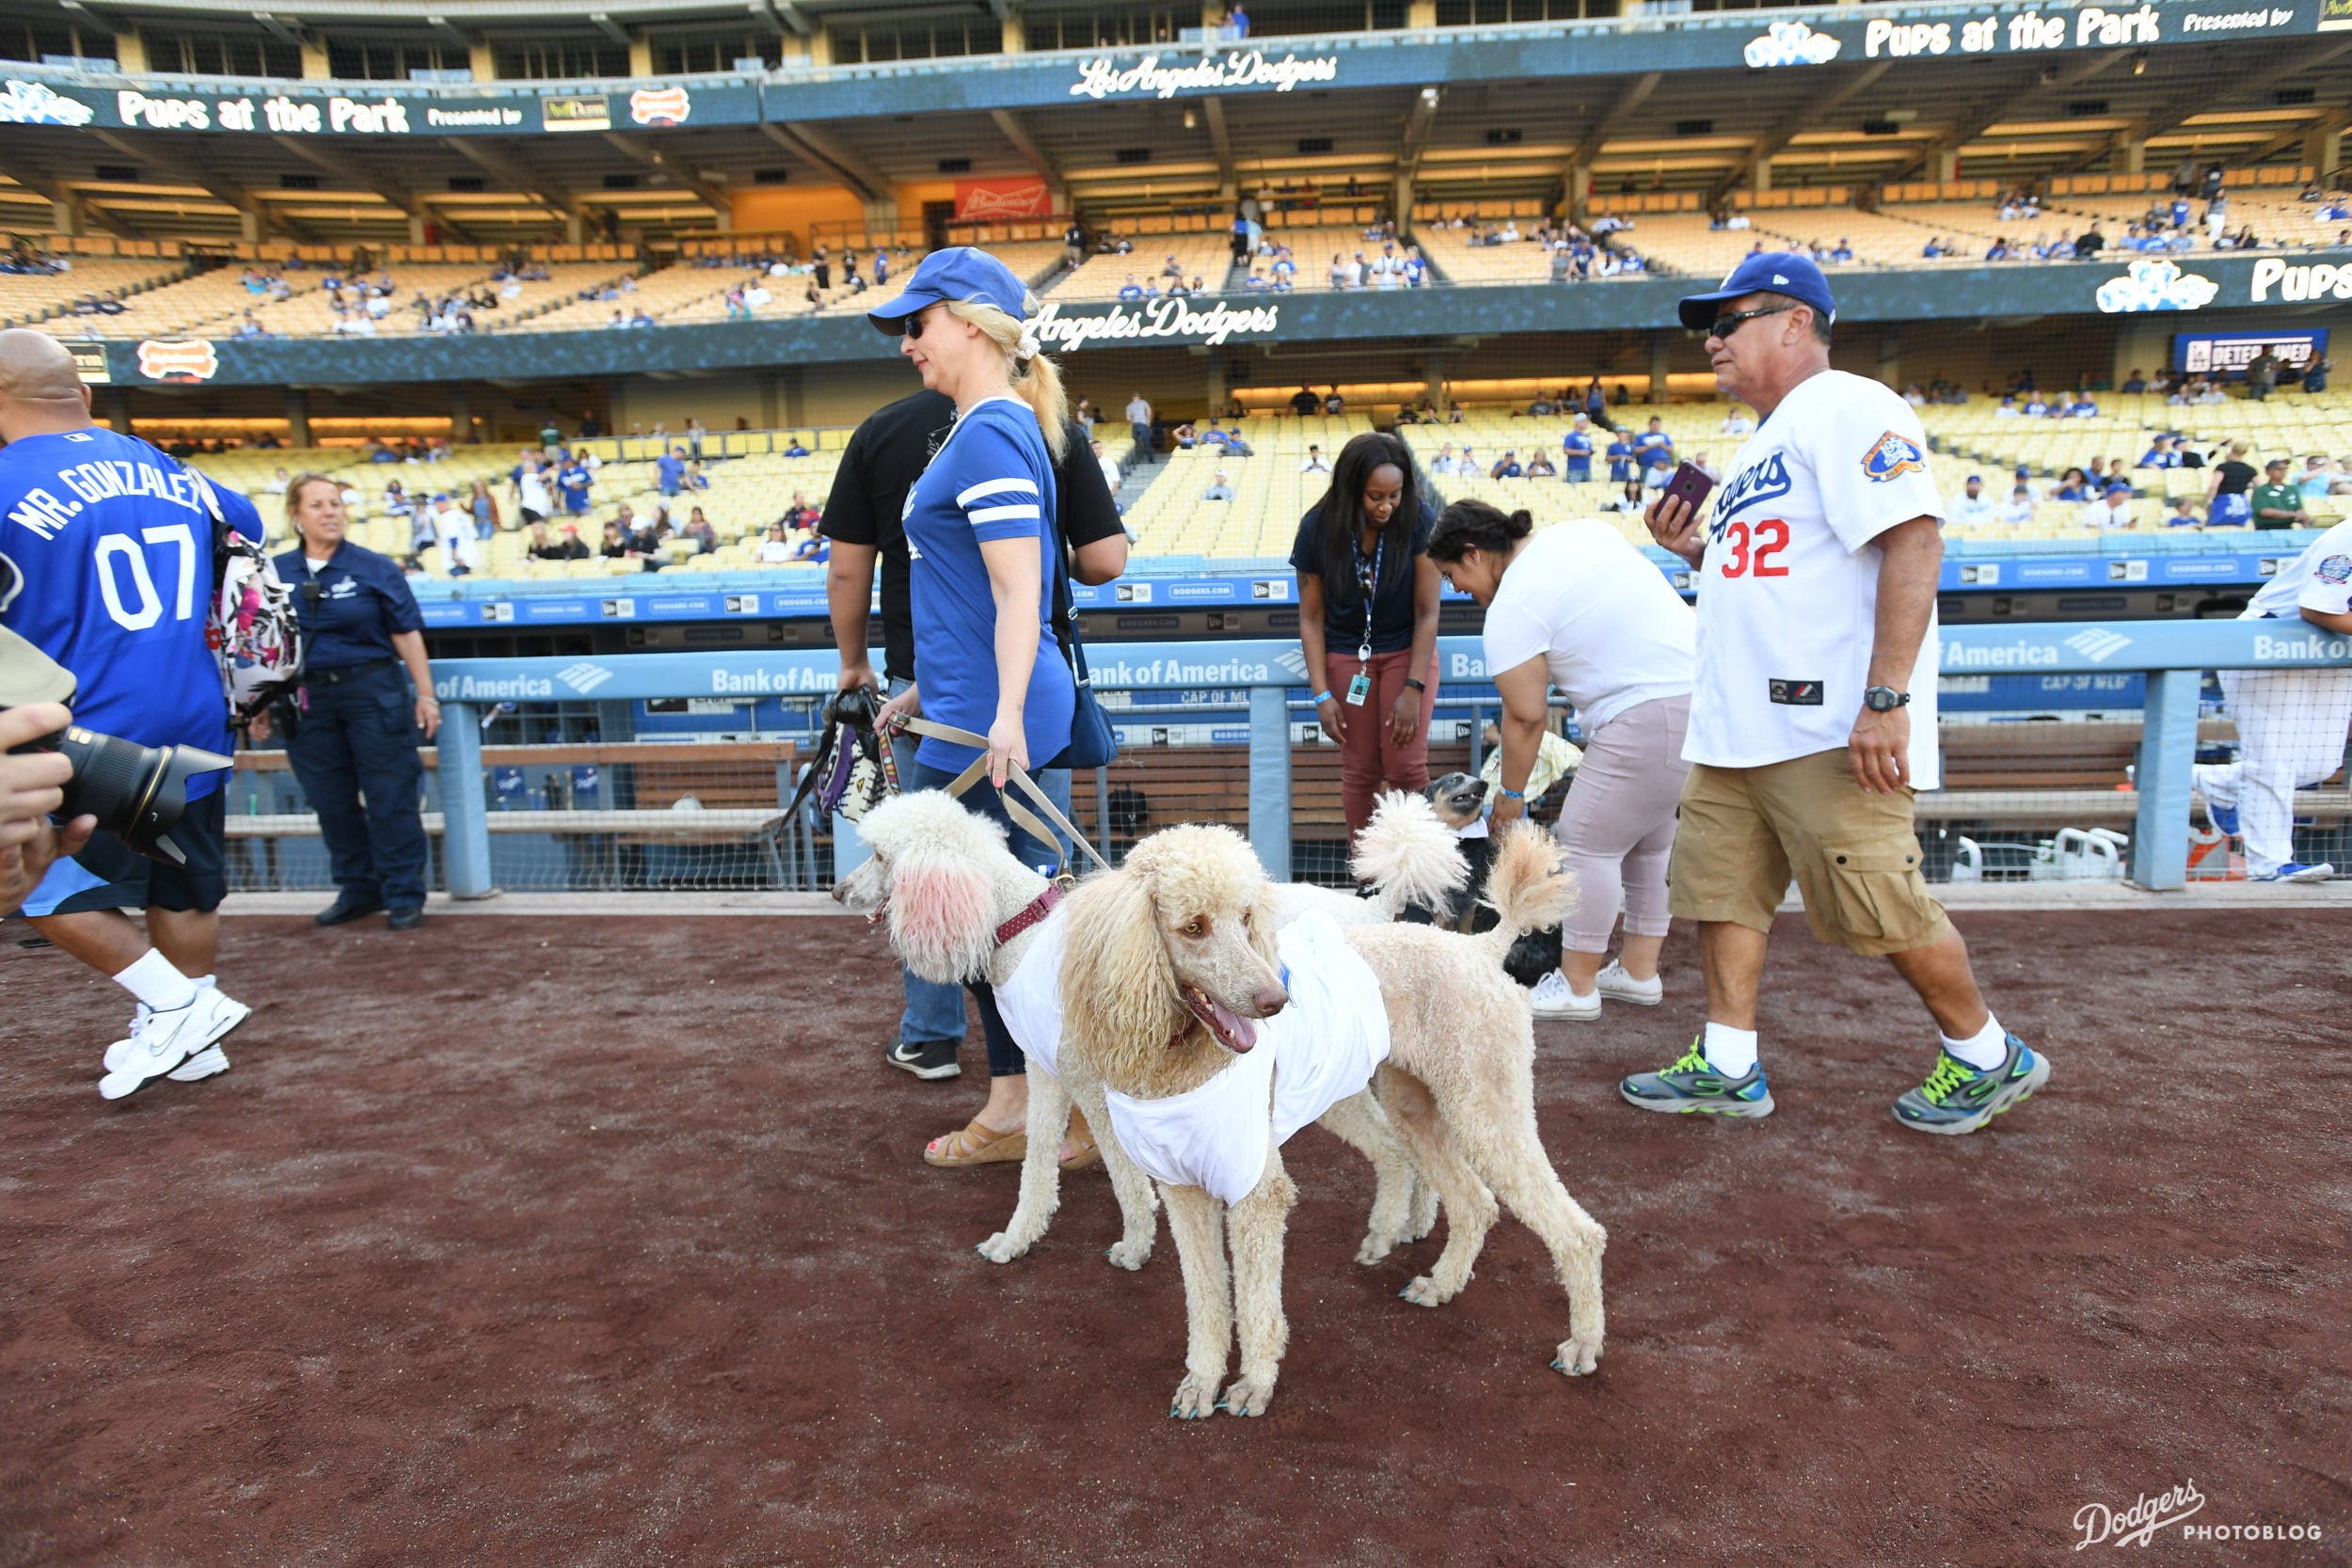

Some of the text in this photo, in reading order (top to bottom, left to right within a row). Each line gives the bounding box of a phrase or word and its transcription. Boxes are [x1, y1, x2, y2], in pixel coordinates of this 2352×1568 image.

[1866, 19, 1950, 57] Pups
[1961, 16, 1997, 52] at
[2009, 10, 2065, 49] the
[2076, 4, 2160, 46] Park
[2183, 9, 2266, 32] Presented
[2270, 8, 2294, 26] by
[1070, 50, 1337, 99] Los Angeles Dodgers
[118, 90, 210, 129] Pups
[218, 97, 255, 131] at
[263, 96, 321, 133] the
[330, 97, 410, 133] Park
[427, 107, 501, 126] Presented
[2251, 259, 2352, 302] Pups
[1024, 297, 1279, 352] Angeles Dodgers
[2212, 342, 2313, 365] DETERINED
[8, 488, 84, 541] MR.
[1722, 519, 1790, 578] 32
[94, 523, 196, 631] 07
[1947, 640, 2058, 666] America
[2253, 634, 2326, 659] Bank
[437, 674, 552, 699] of America
[712, 668, 771, 692] Bank
[772, 667, 799, 690] of
[1136, 659, 1162, 684] of
[1165, 658, 1268, 683] America
[1181, 689, 1249, 704] CAP OF ML
